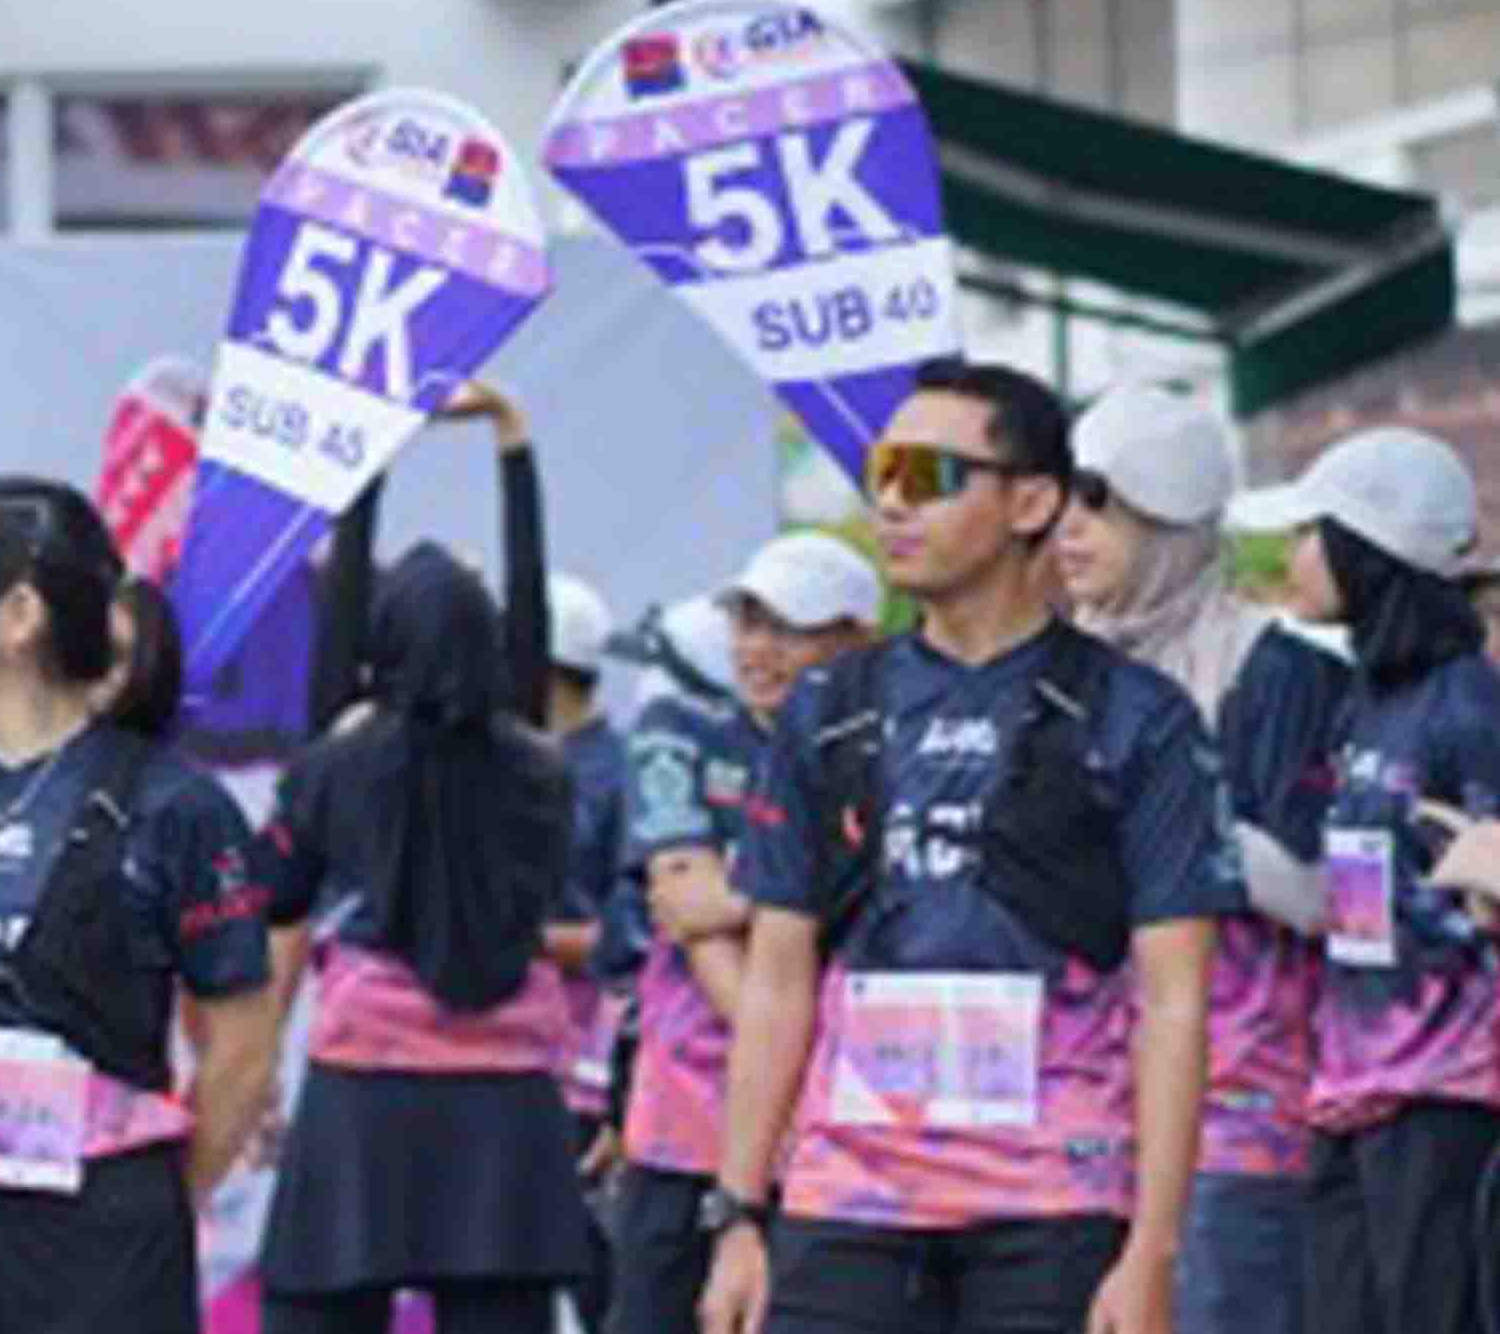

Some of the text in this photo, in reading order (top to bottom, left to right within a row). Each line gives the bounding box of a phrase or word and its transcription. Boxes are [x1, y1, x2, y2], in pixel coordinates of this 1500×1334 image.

[743, 8, 824, 51] GIA
[586, 75, 876, 162] PACER
[684, 117, 904, 276] 5K
[264, 221, 452, 405] 5K
[752, 278, 940, 352] SUB 40
[222, 386, 310, 449] SUB
